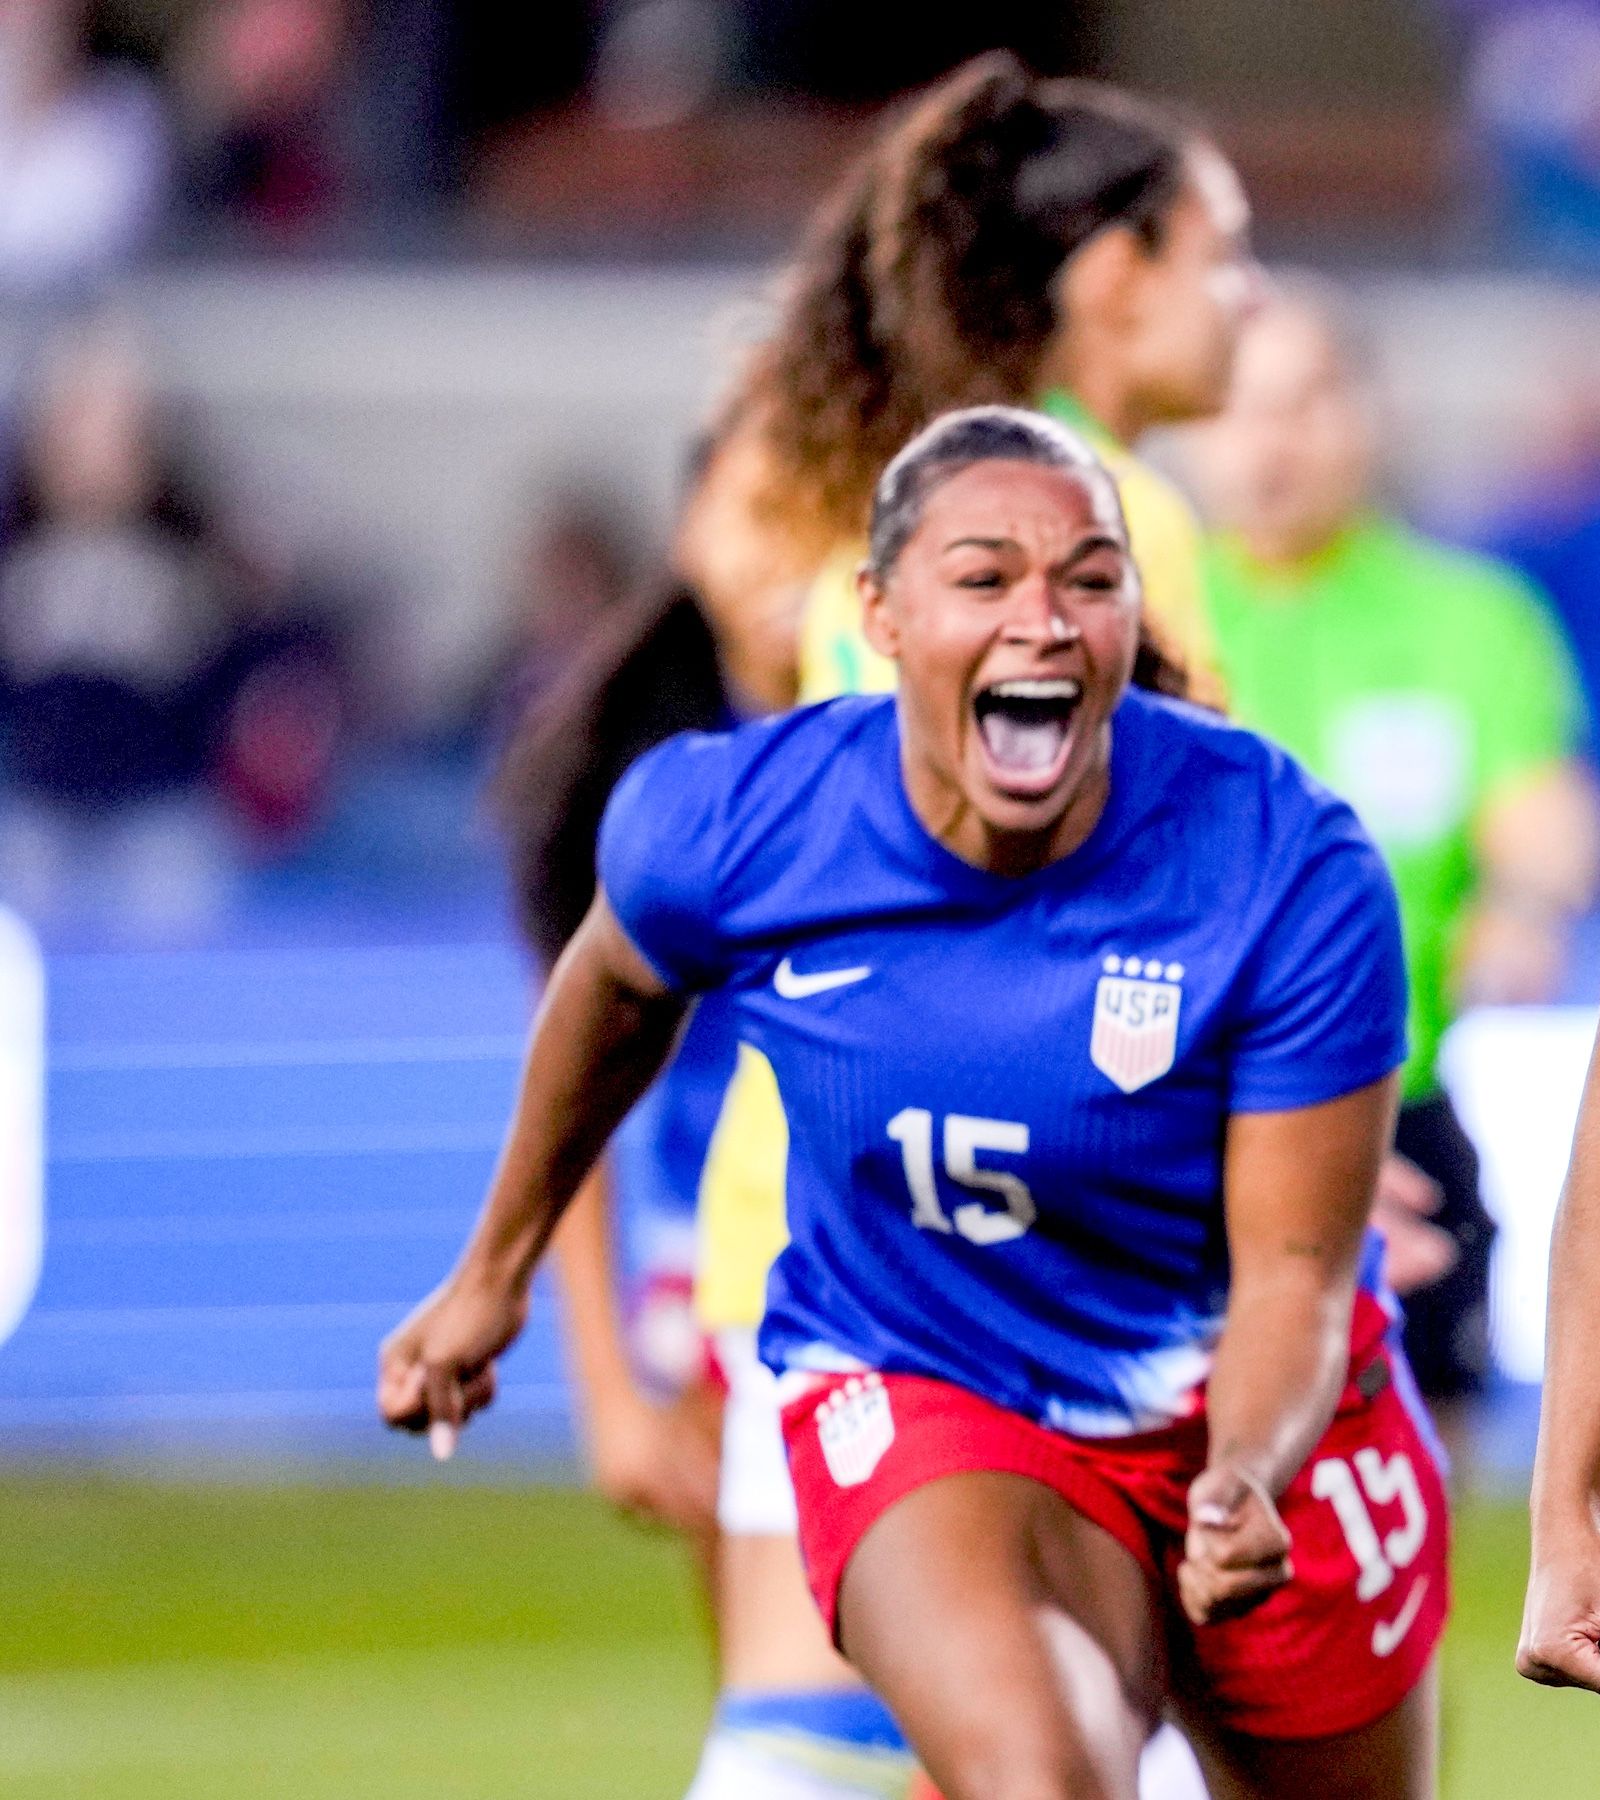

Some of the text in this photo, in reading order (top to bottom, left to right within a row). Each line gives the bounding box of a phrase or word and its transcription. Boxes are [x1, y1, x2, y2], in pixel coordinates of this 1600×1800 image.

[1105, 987, 1170, 1027] USA
[886, 1107, 1037, 1246] 15
[1310, 1446, 1429, 1602] 15
